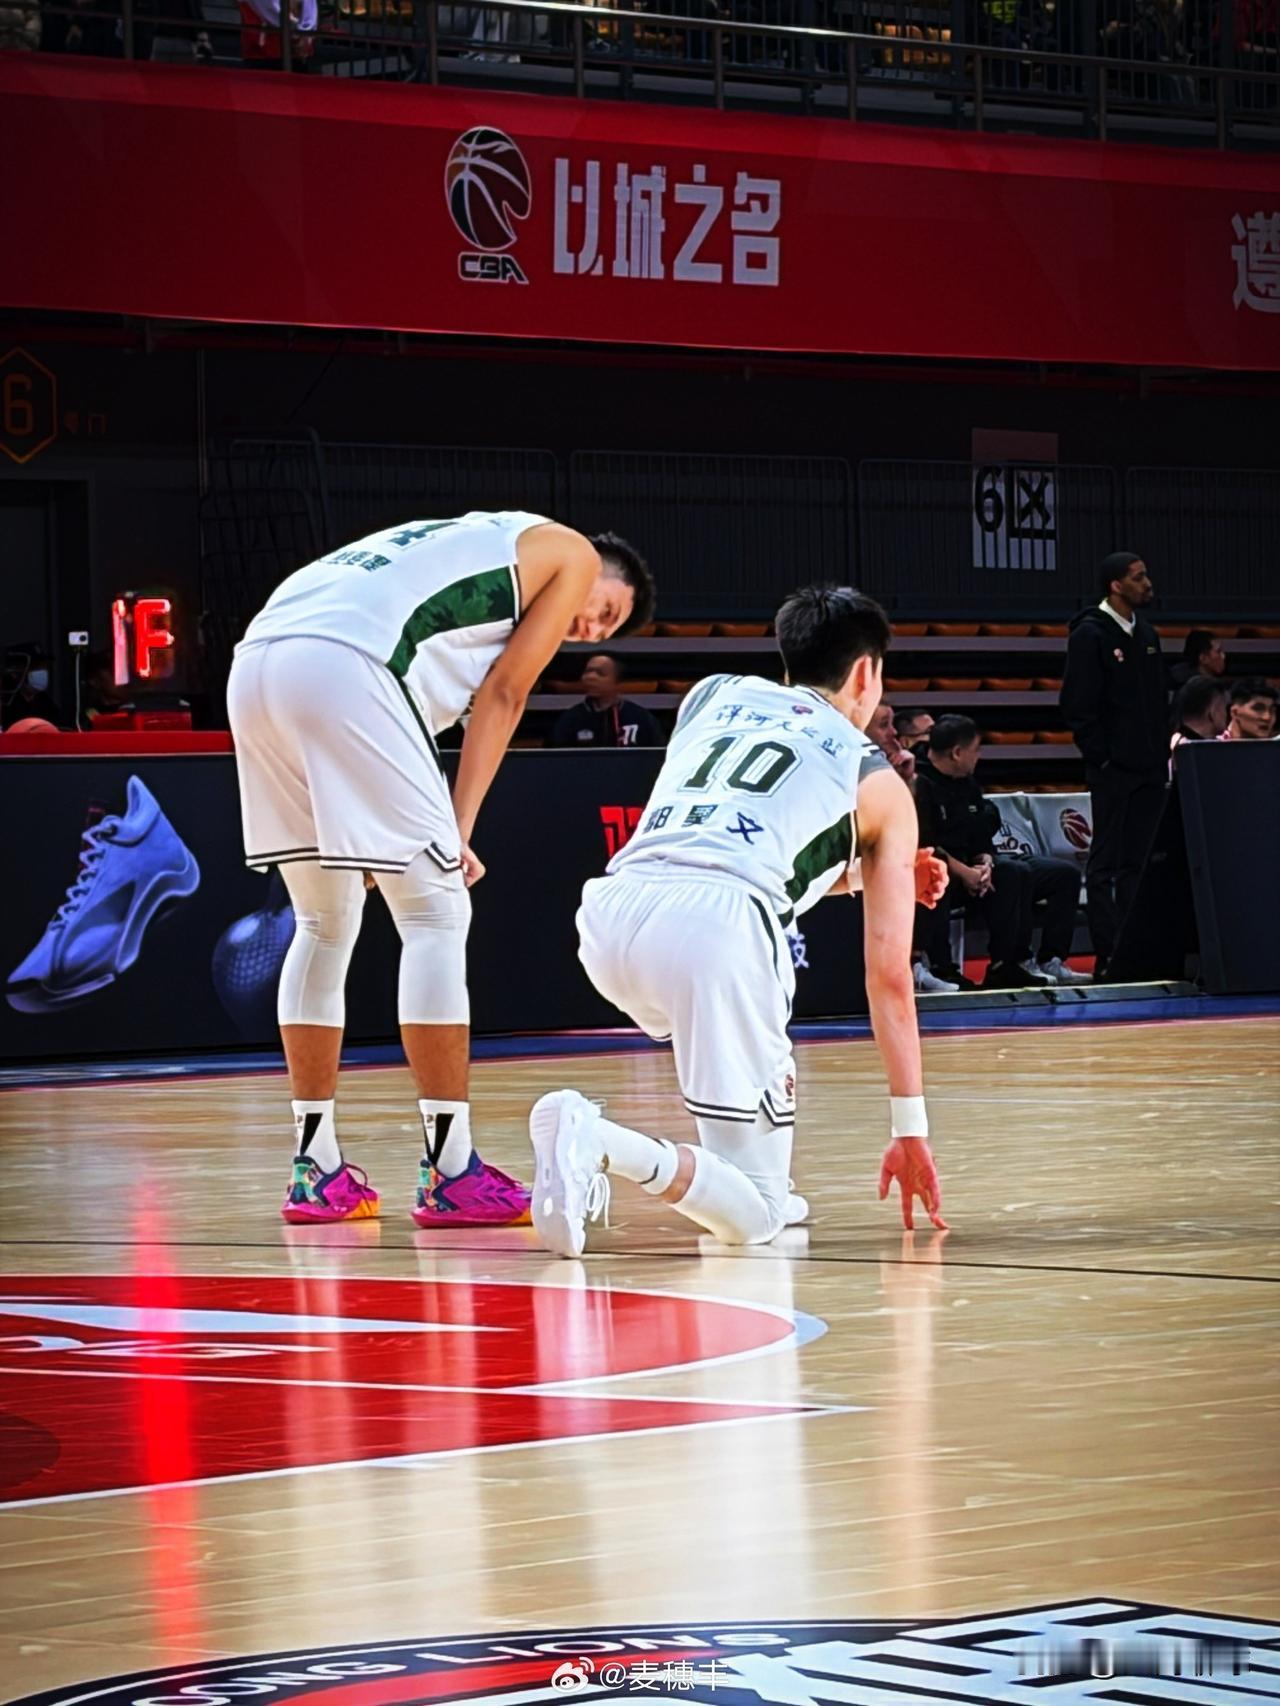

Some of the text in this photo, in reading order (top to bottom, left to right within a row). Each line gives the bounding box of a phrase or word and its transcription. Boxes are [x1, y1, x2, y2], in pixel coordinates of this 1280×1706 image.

[553, 157, 781, 287] 以城之名
[457, 251, 530, 285] CBA
[975, 464, 1057, 540] 6区
[681, 735, 800, 796] 10
[415, 1632, 791, 1666] LIONS
